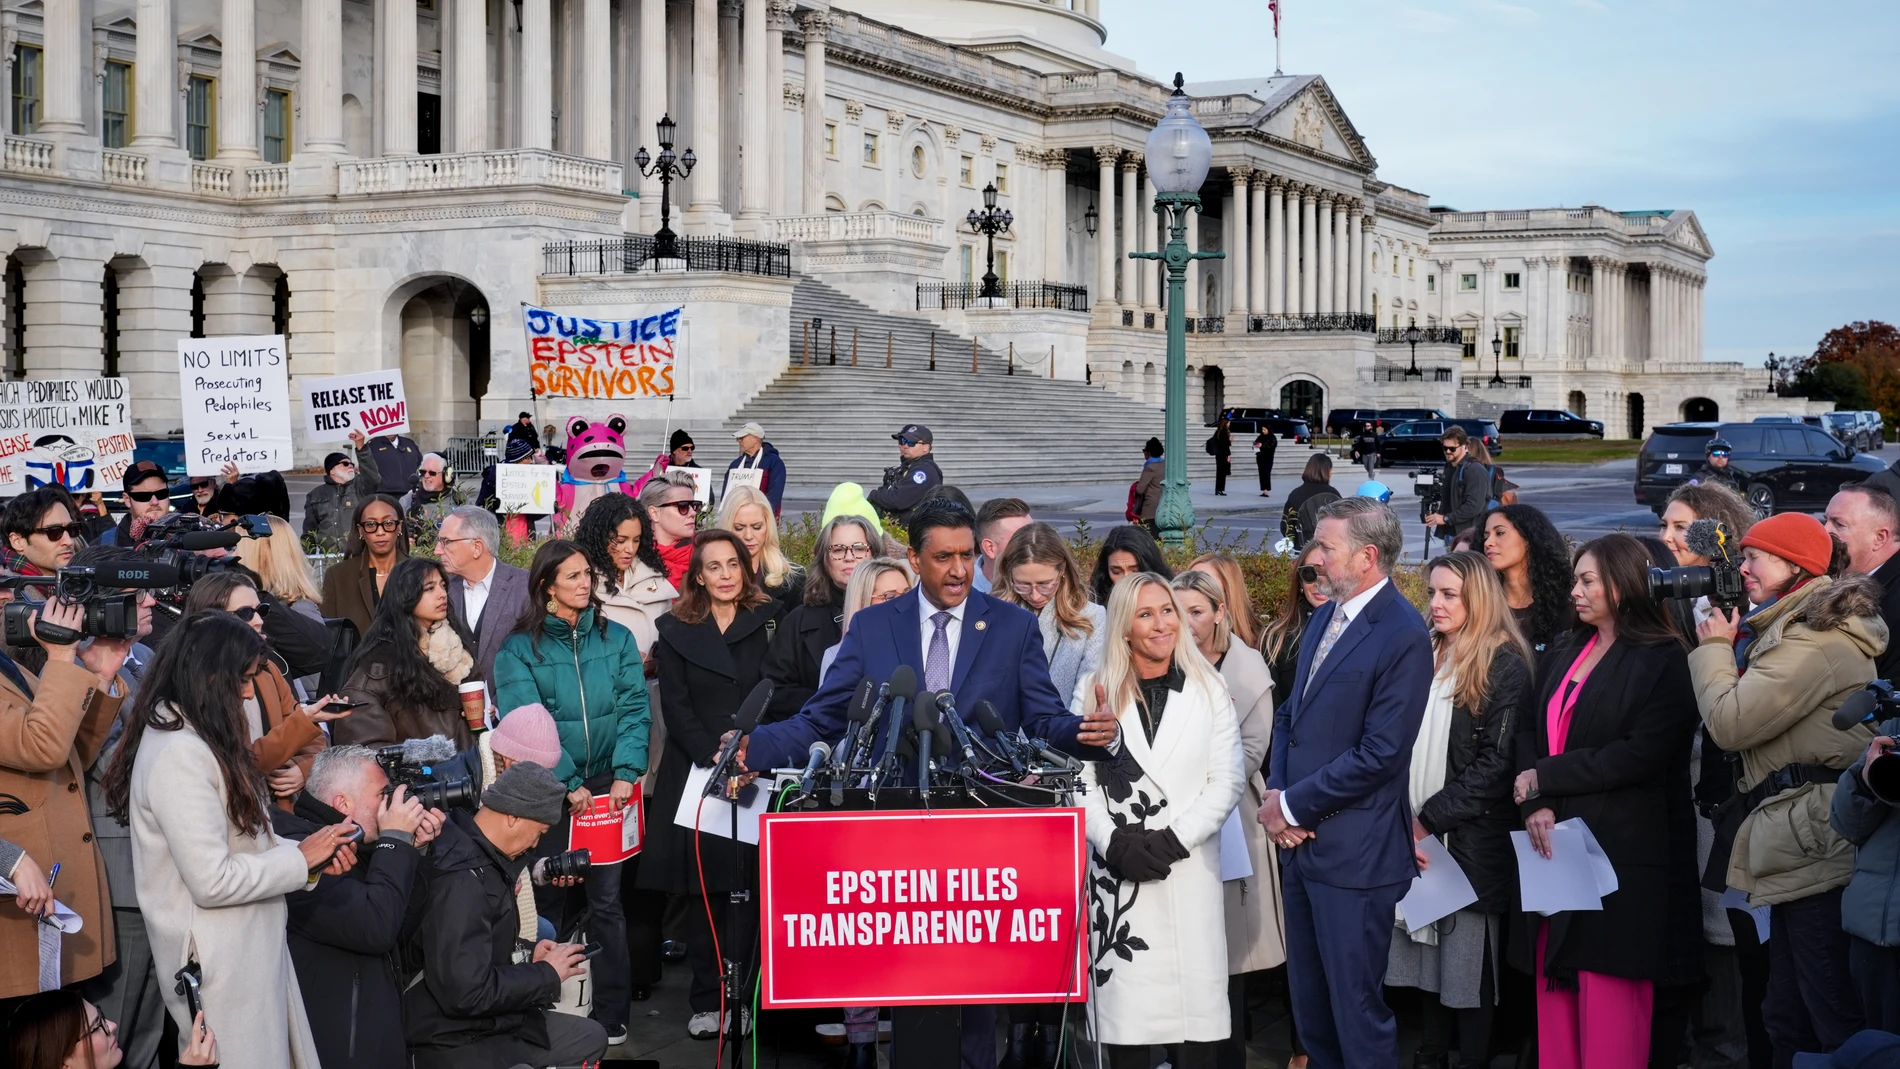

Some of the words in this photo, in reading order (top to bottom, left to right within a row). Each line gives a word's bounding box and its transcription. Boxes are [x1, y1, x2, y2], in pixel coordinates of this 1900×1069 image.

[527, 308, 680, 343] JUSTICE
[532, 337, 674, 368] EPSTEIN
[572, 335, 609, 346] FOR
[184, 350, 210, 369] NO
[221, 347, 280, 368] LIMITS
[27, 380, 79, 404] PEDOPHILES
[85, 378, 123, 401] WOULD
[195, 376, 262, 393] Prosecuting
[530, 362, 674, 399] SURVIVORS
[205, 396, 272, 414] Pedophiles
[311, 386, 367, 409] RELEASE
[367, 382, 395, 402] THE
[314, 411, 351, 431] FILES
[359, 401, 406, 430] NOW!
[97, 432, 135, 457] EPSTEIN
[118, 570, 150, 580] RØDE
[826, 869, 938, 905] EPSTEIN
[947, 867, 1018, 902] FILES
[783, 909, 1001, 947] TRANSPARENCY
[1009, 908, 1062, 943] ACT
